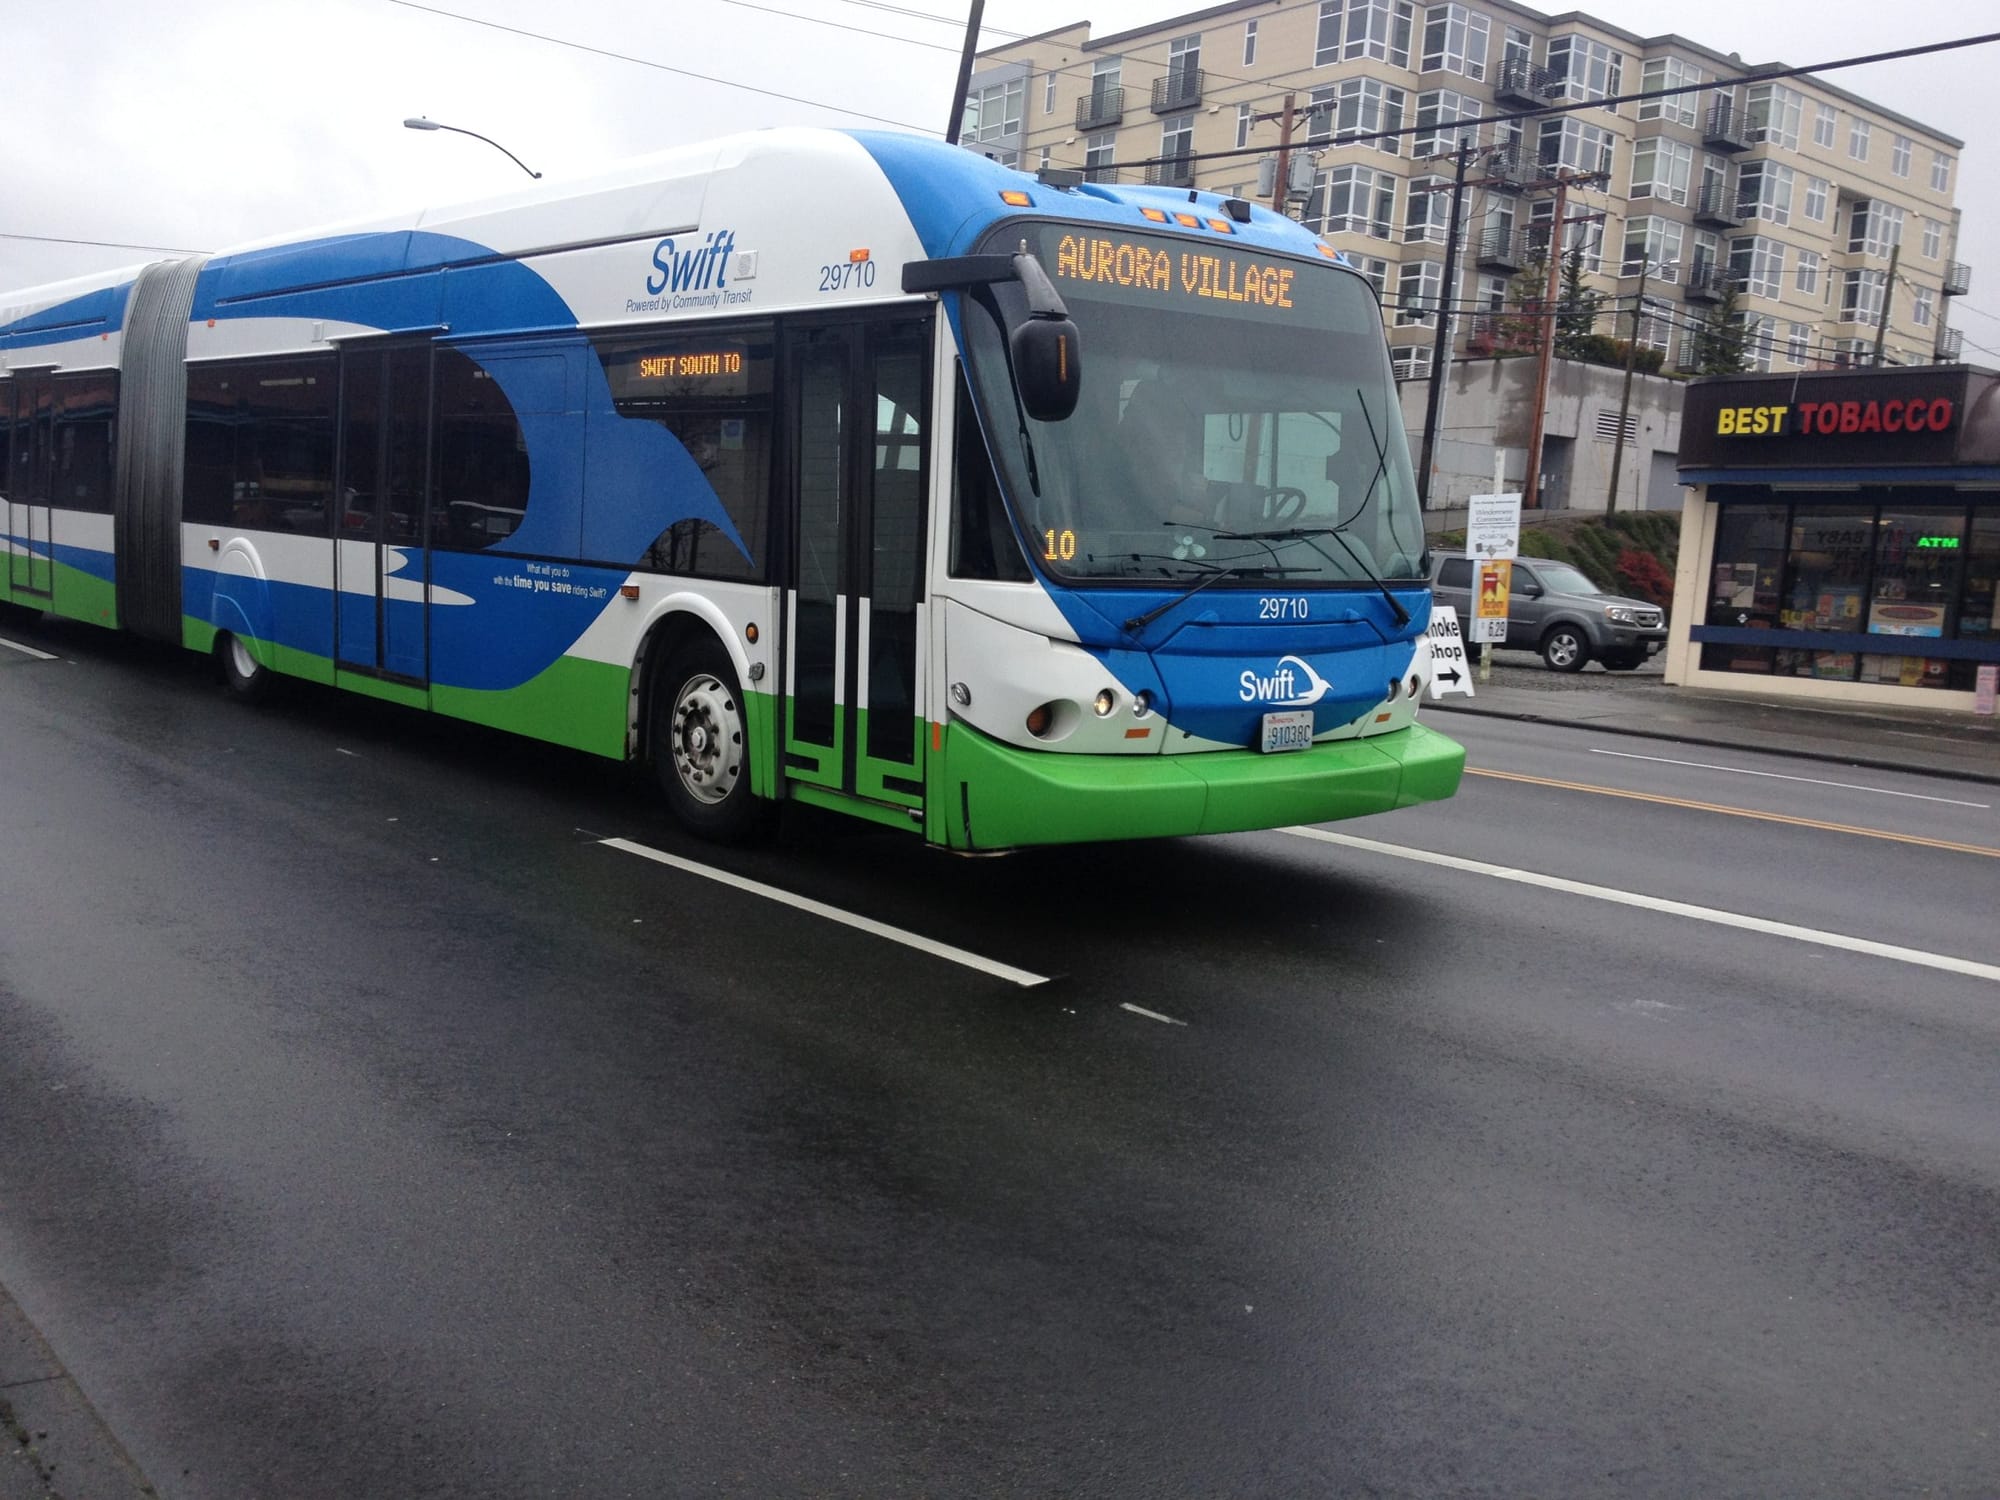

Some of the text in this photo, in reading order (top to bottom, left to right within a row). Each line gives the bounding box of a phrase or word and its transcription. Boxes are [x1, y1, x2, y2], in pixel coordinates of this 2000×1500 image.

[647, 230, 735, 295] Swift
[1057, 235, 1294, 308] AURORA VILLAGE
[819, 261, 875, 291] 29710
[625, 288, 752, 312] Powered by Community Transit
[640, 352, 741, 377] SWIFT SOUTH TO
[1717, 398, 1952, 435] BEST TOBACCO
[1044, 528, 1077, 561] 10
[1917, 537, 1960, 548] ATM
[527, 563, 570, 578] What will you do
[513, 575, 532, 589] time
[534, 580, 549, 593] you
[551, 582, 572, 594] save
[573, 586, 588, 599] riding
[589, 586, 607, 599] Swift?
[1259, 598, 1309, 619] 29710
[1430, 616, 1459, 637] moke
[1239, 669, 1295, 701] Swift
